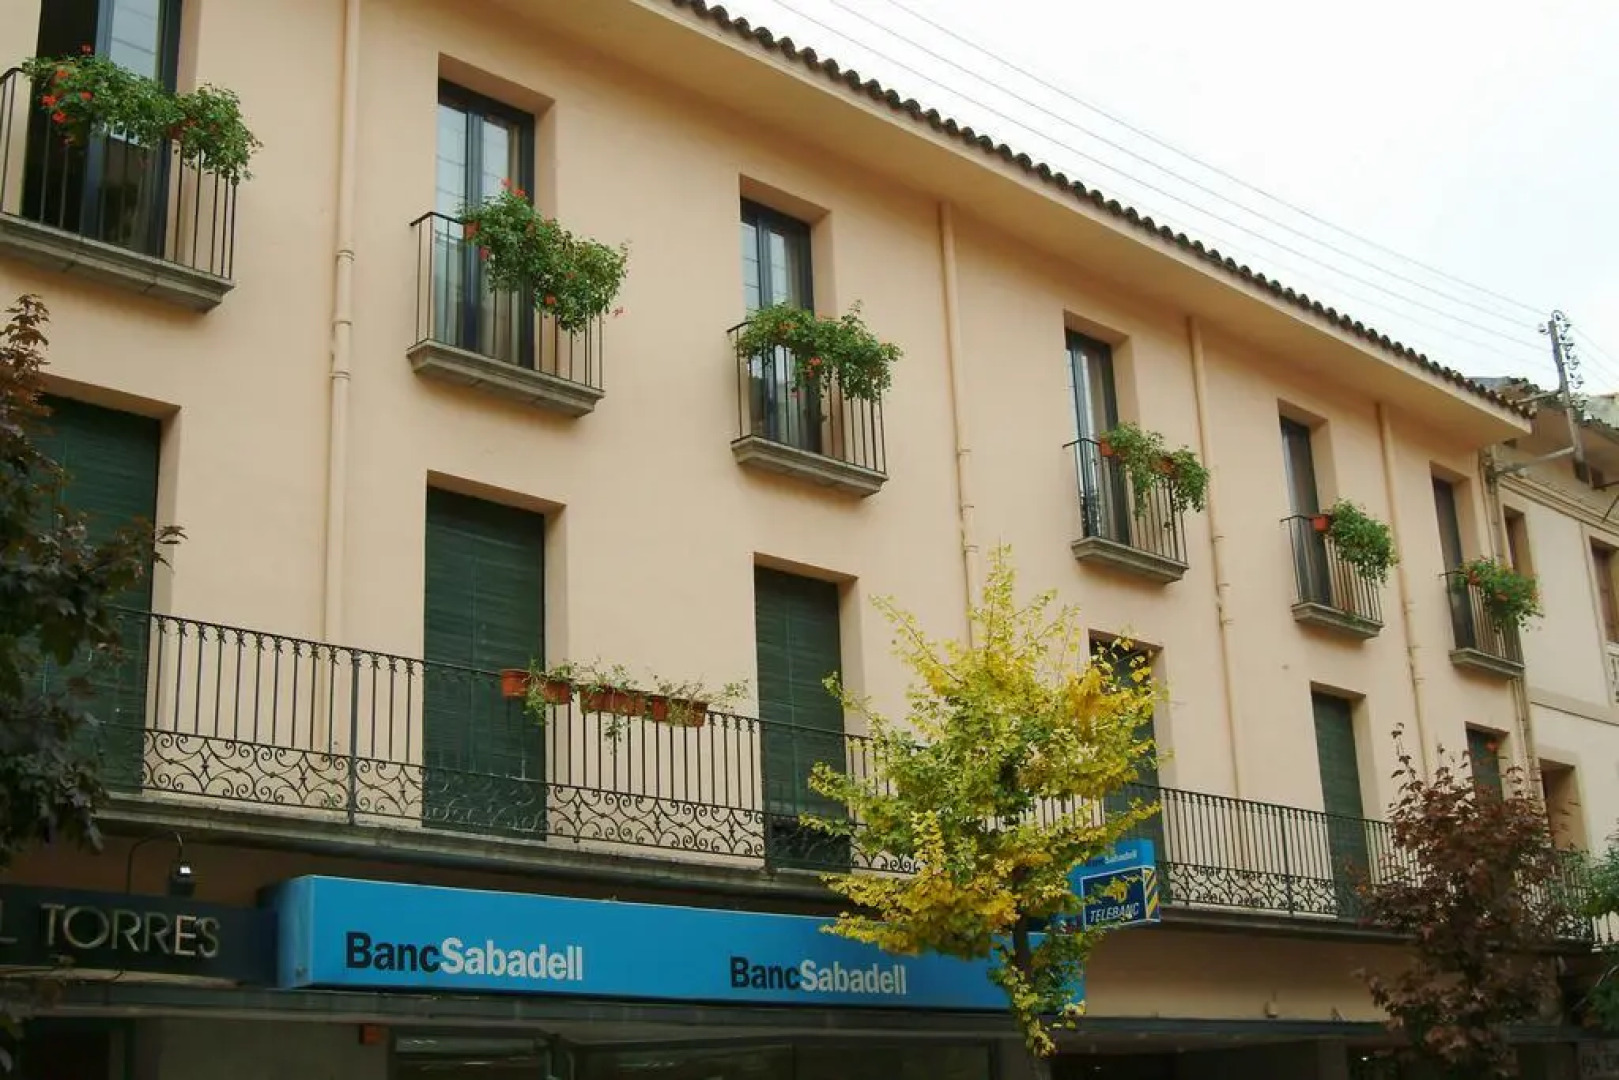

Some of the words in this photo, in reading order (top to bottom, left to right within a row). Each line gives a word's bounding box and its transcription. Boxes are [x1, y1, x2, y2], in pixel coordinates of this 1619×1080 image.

[41, 902, 220, 958] TORRES
[1090, 903, 1139, 923] TELEBANC
[346, 931, 583, 981] BancSabadell
[730, 956, 907, 995] BancSabadell
